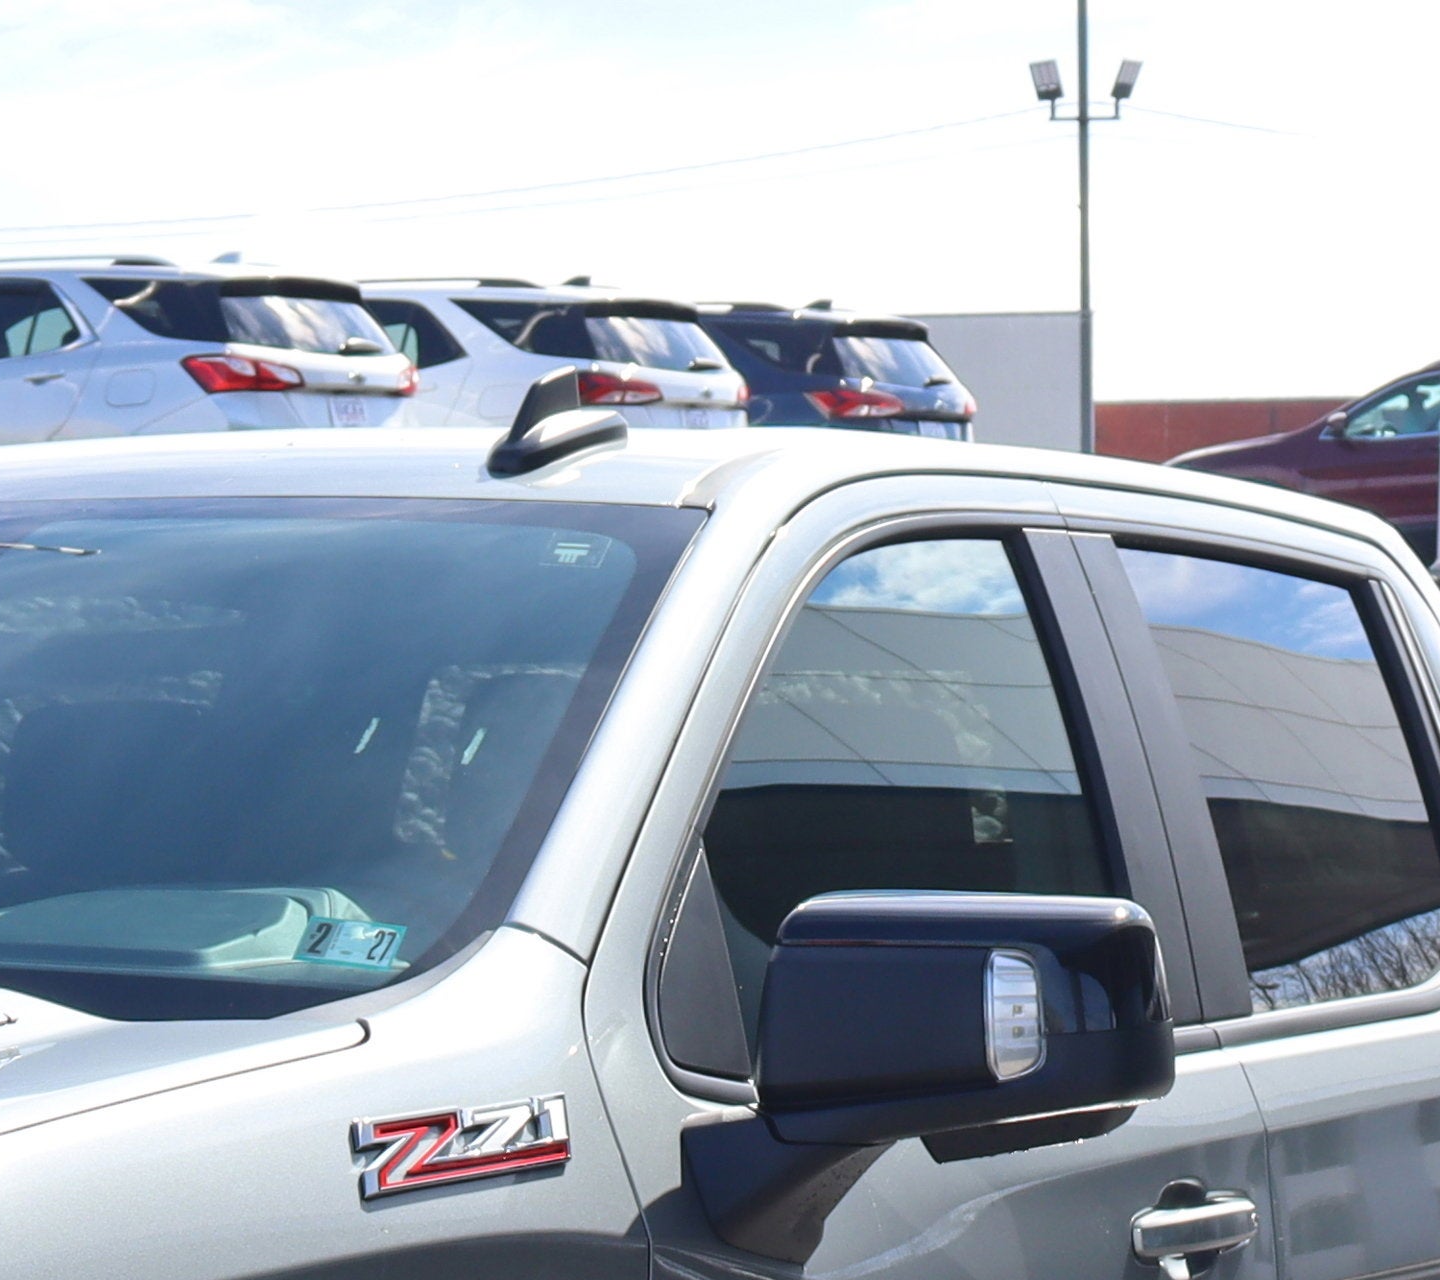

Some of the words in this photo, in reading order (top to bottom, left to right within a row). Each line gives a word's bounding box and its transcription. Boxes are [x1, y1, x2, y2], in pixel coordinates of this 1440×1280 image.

[307, 922, 333, 954] 2
[366, 929, 397, 964] 27
[349, 1092, 571, 1200] Z71
